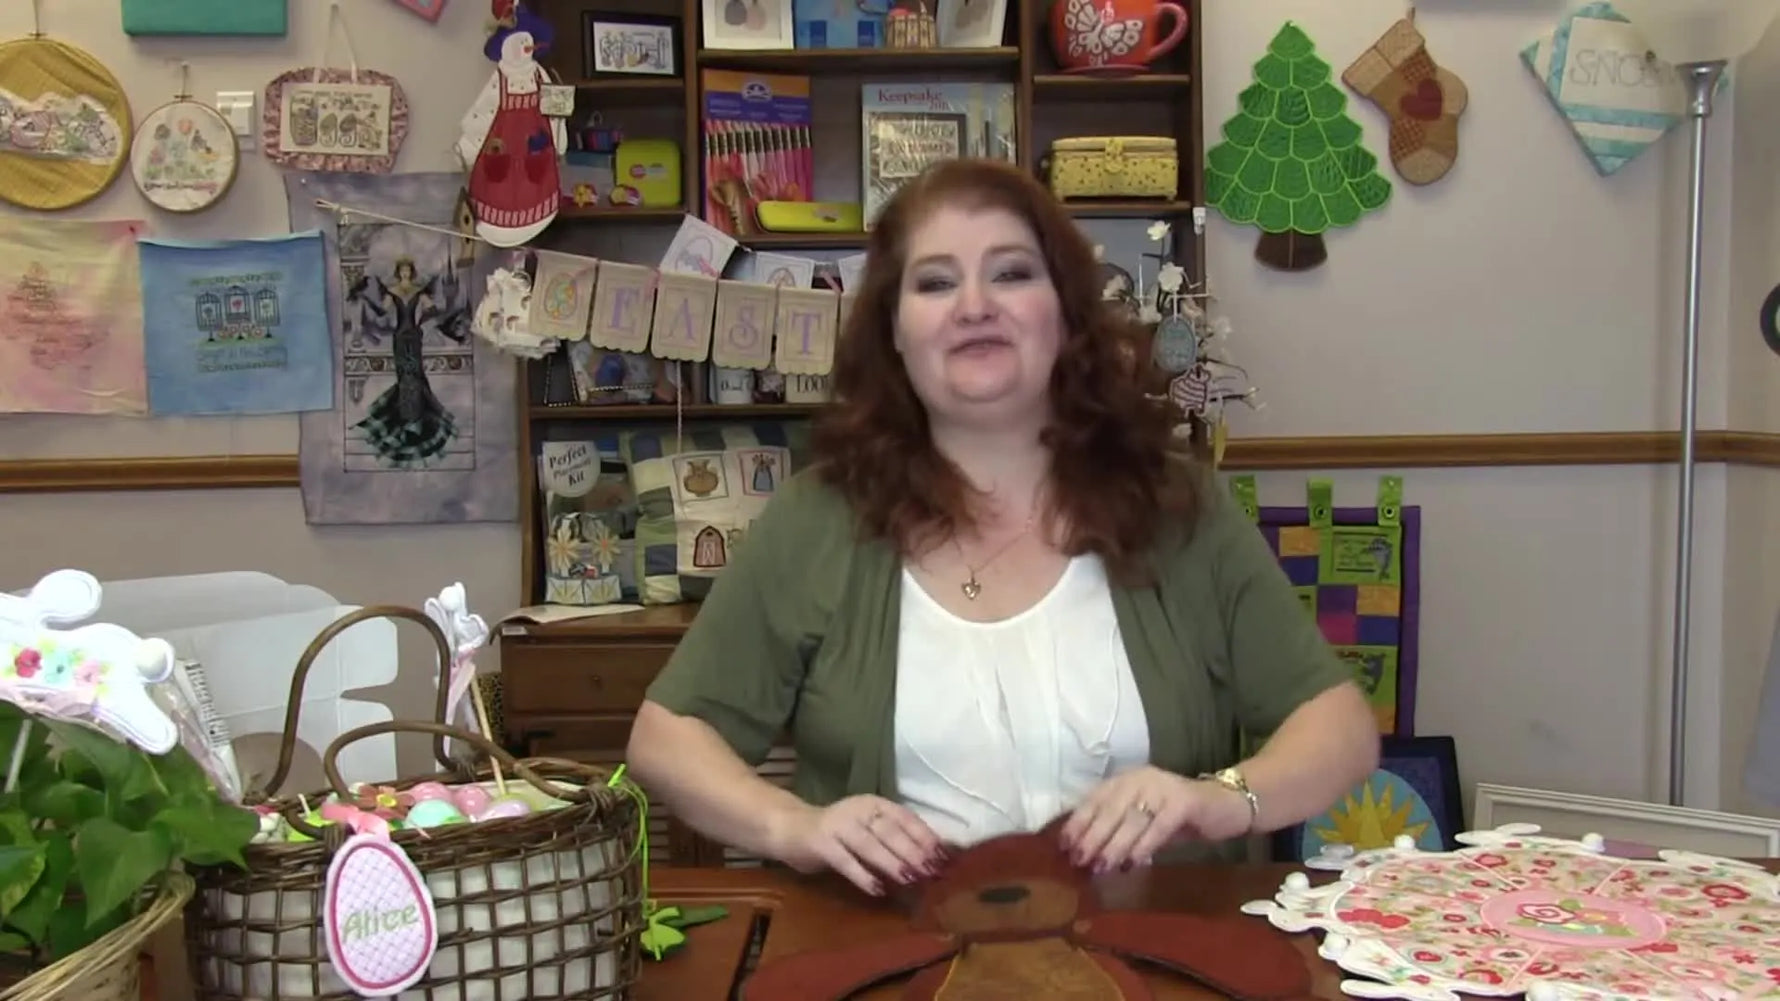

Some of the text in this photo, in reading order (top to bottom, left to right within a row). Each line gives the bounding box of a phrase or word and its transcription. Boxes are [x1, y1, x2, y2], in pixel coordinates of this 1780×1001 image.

[878, 88, 942, 104] Keepsake
[549, 444, 586, 470] Perfect
[568, 470, 584, 486] Kit
[343, 904, 419, 943] Alice
